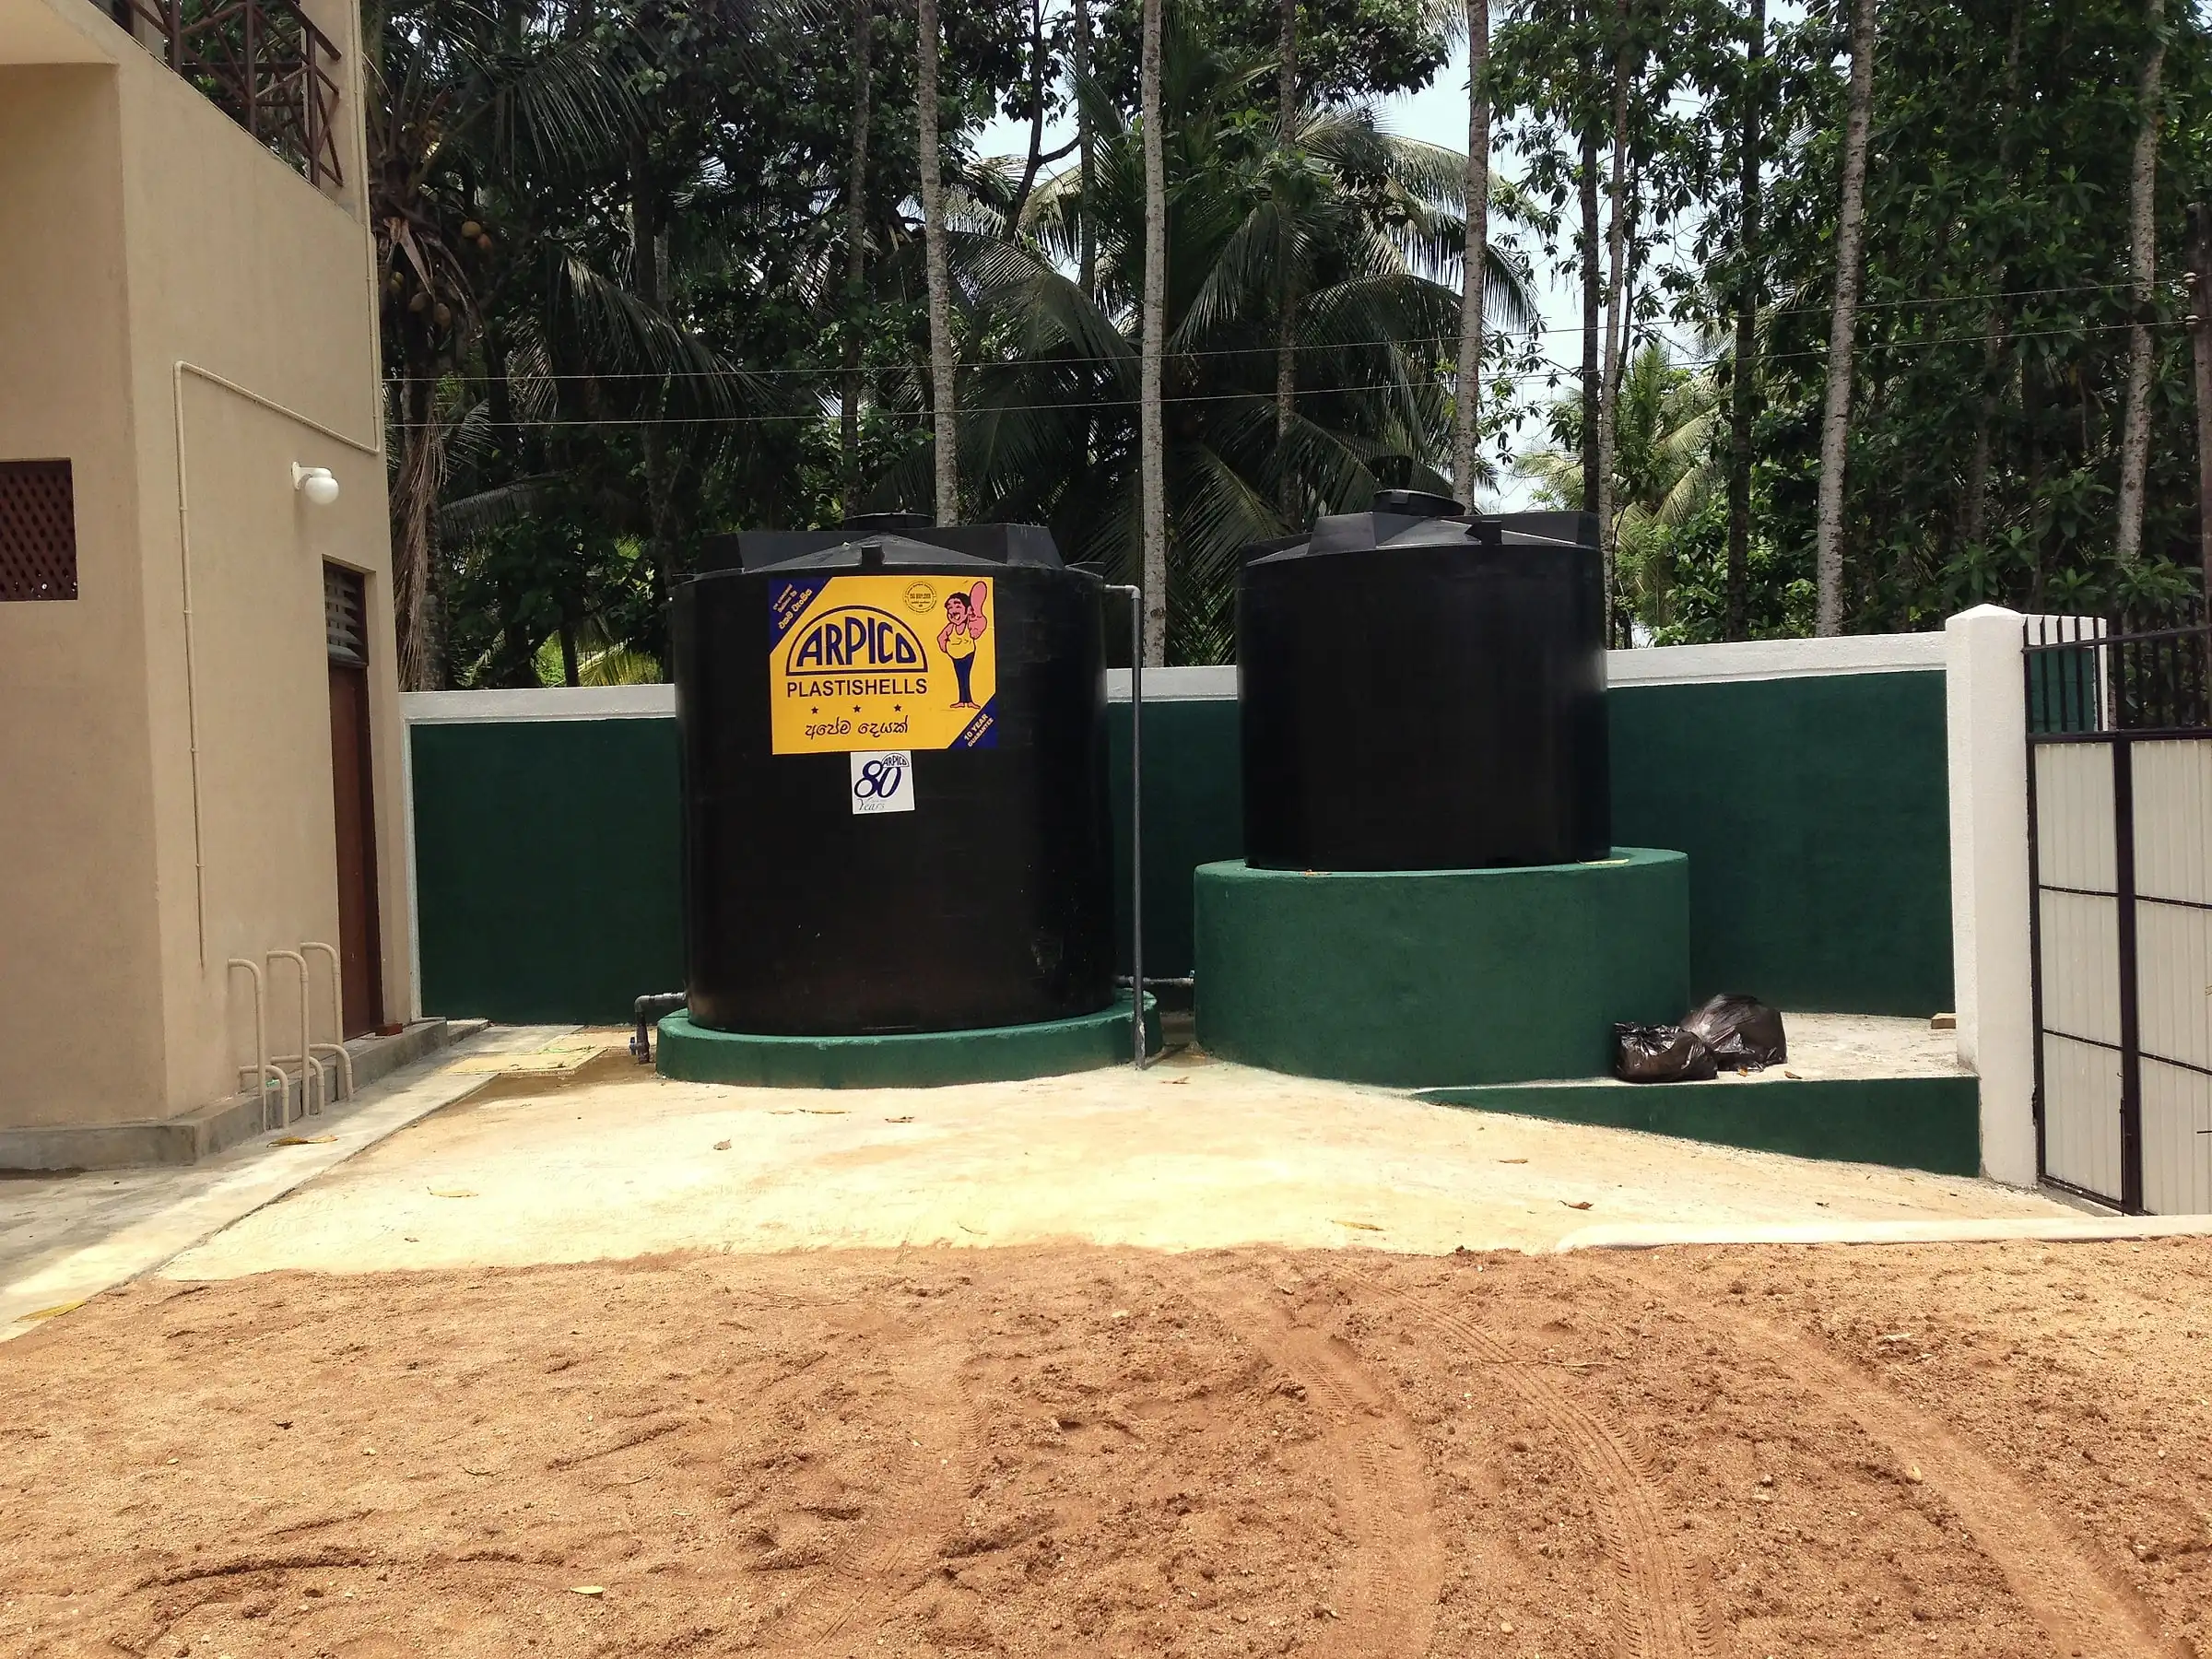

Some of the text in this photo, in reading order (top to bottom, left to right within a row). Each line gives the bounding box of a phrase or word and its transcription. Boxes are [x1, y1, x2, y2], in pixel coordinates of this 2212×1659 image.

[796, 616, 917, 667] ARPICO
[786, 678, 928, 699] PLASTISHELLS
[964, 713, 989, 741] 10 YEAR
[968, 717, 994, 747] GUARANTEE
[882, 755, 908, 767] ARPICO
[853, 759, 902, 799] 80
